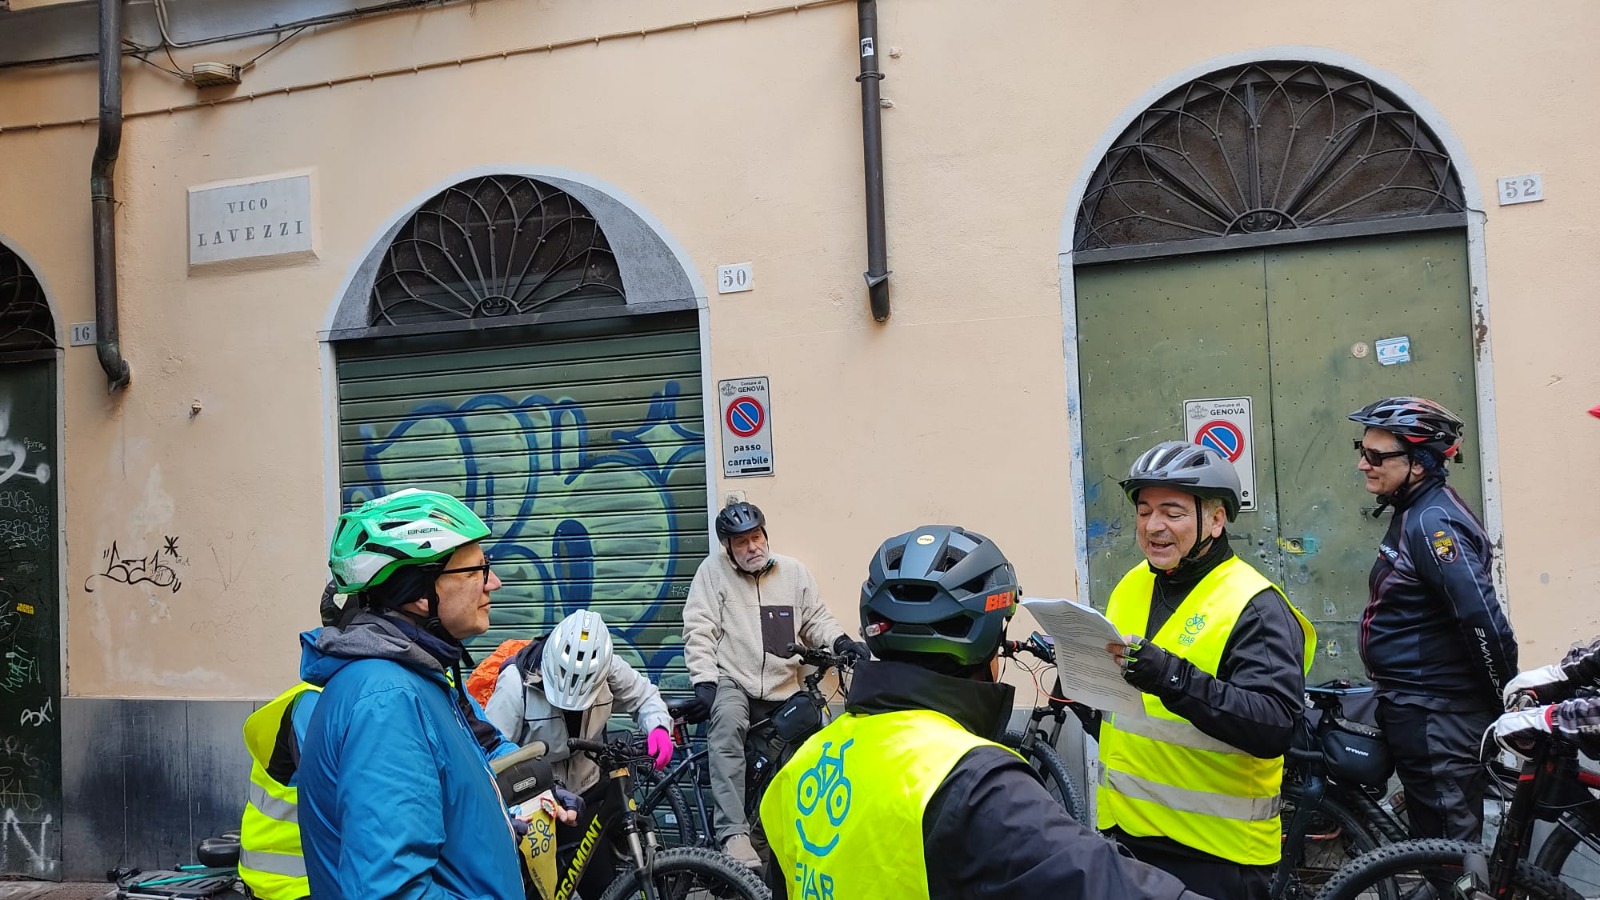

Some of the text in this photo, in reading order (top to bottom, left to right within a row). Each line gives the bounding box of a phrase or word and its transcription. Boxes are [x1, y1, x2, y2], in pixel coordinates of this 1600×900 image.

[1505, 178, 1536, 199] 52
[226, 197, 268, 214] VICO
[197, 220, 303, 247] LAVEZZI
[723, 269, 747, 287] 50
[74, 326, 90, 342] 16
[737, 385, 765, 393] GENOVA
[1210, 407, 1245, 416] GENOVA
[733, 443, 761, 454] passo
[727, 455, 769, 467] carrabile
[527, 822, 541, 859] FIAB
